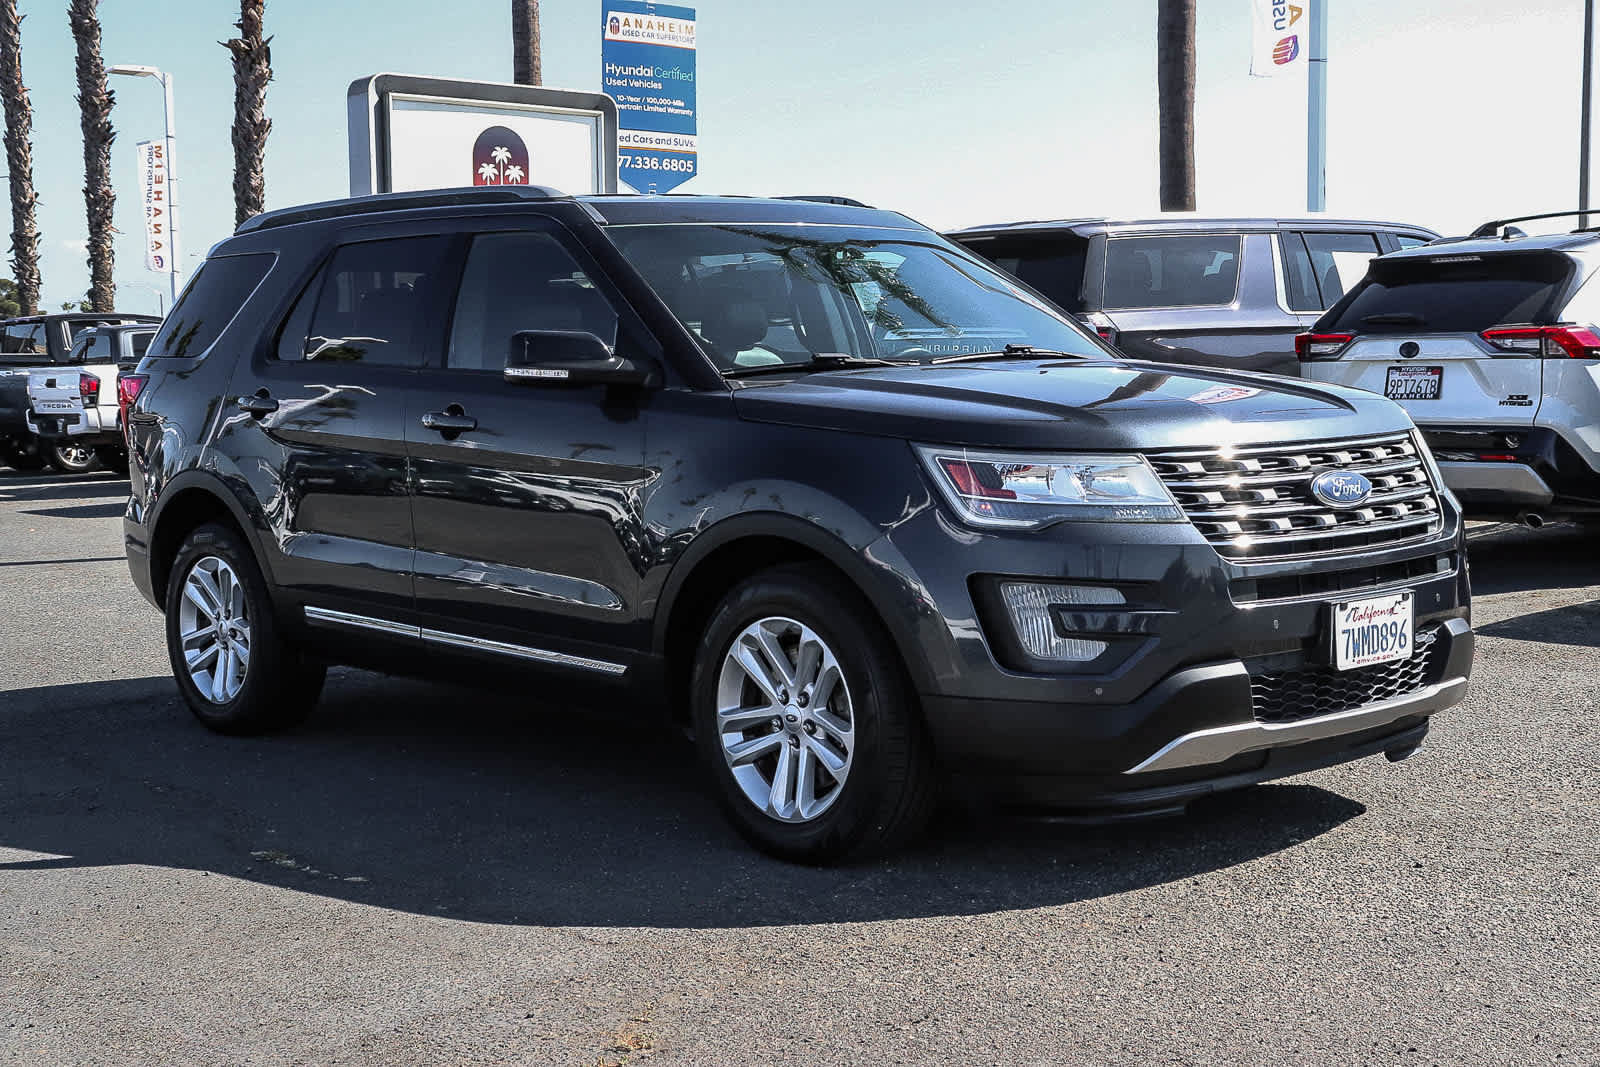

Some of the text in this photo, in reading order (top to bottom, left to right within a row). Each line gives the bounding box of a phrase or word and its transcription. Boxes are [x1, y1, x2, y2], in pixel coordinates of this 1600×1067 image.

[622, 17, 694, 36] ANAHEIM
[622, 29, 640, 38] USED
[642, 30, 655, 39] CAR
[605, 62, 694, 82] Hyundai Certified
[605, 77, 663, 90] Used Vehicles
[616, 94, 641, 103] 10-Year
[616, 103, 694, 117] wertrain Limited Warranty
[618, 133, 631, 143] ed
[632, 134, 654, 145] Cars
[655, 137, 672, 146] and
[617, 154, 694, 173] 77.336.6805
[1390, 379, 1437, 394] 9PTZ678
[1332, 476, 1364, 497] Ford
[1352, 604, 1399, 624] California
[1341, 618, 1408, 660] 7WMD896
